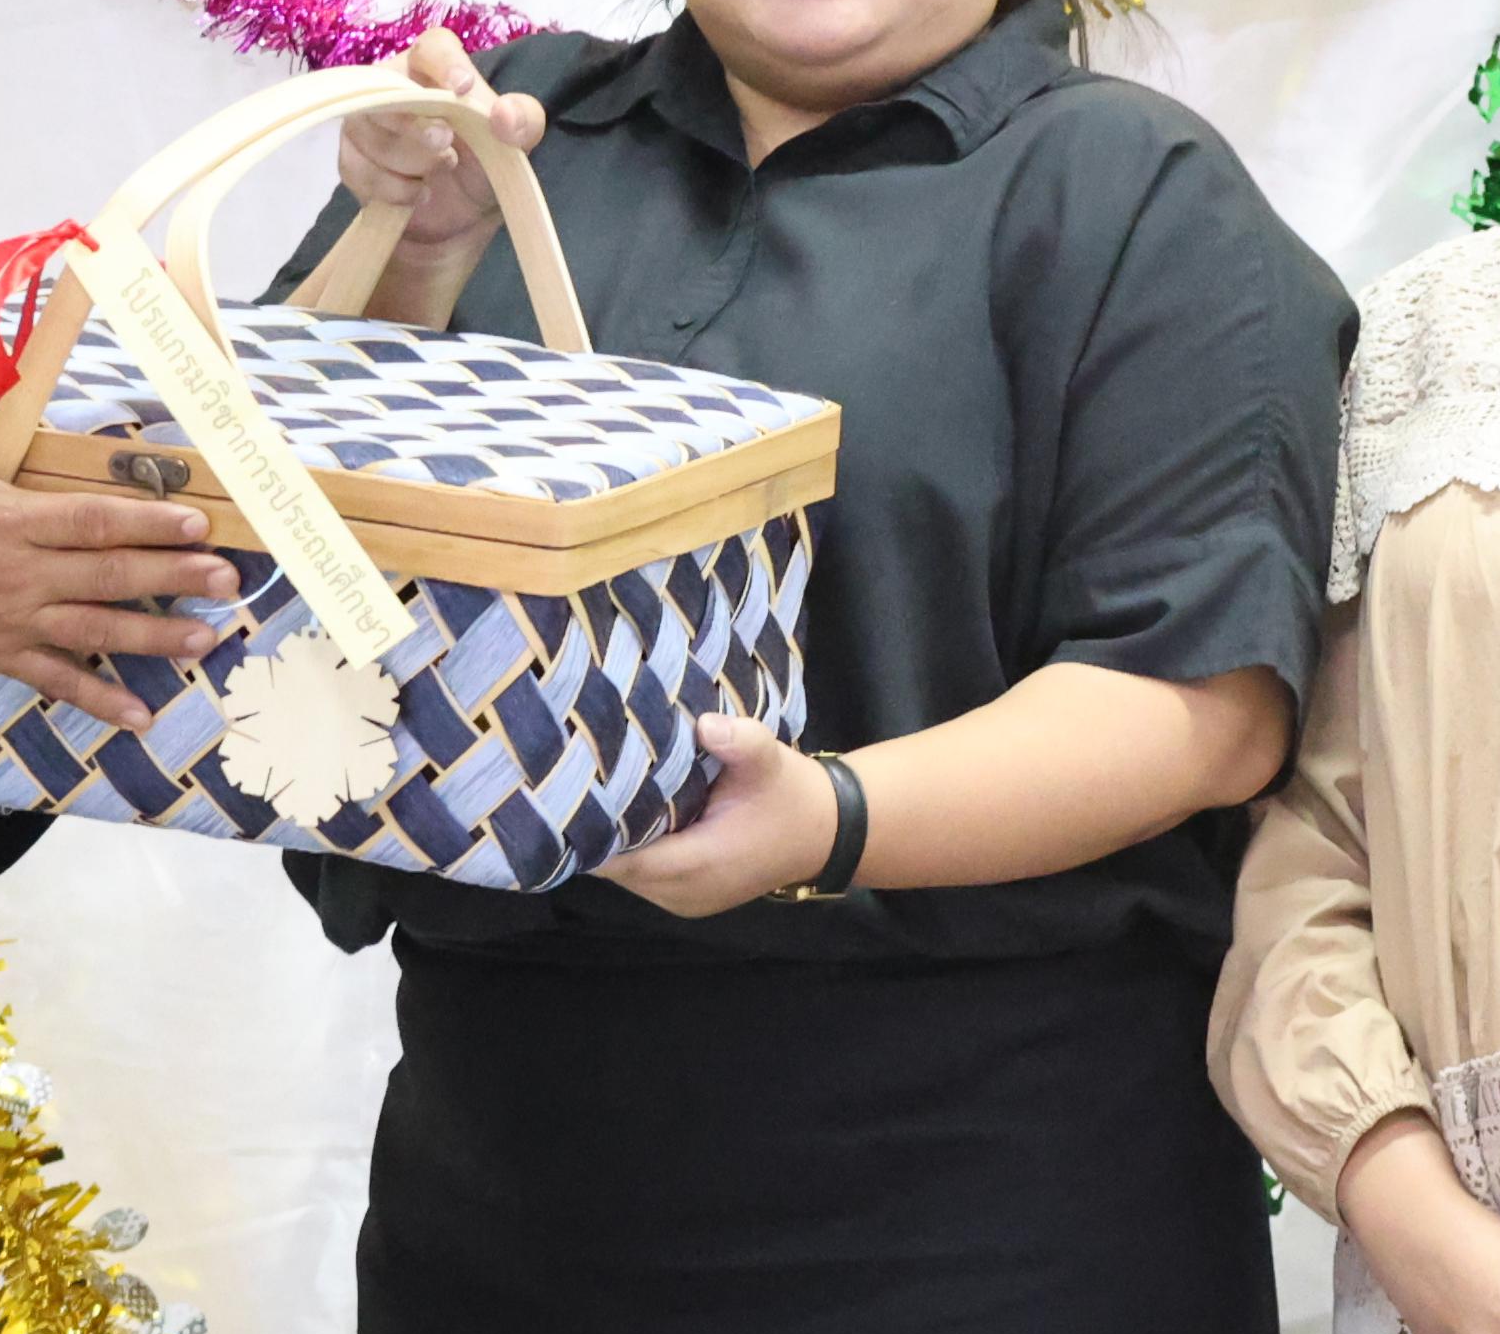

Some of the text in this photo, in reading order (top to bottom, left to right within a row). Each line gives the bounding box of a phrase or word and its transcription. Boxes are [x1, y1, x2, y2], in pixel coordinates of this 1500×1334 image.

[120, 266, 392, 650] โปรแกรมวิชาการประถมศึกษา
